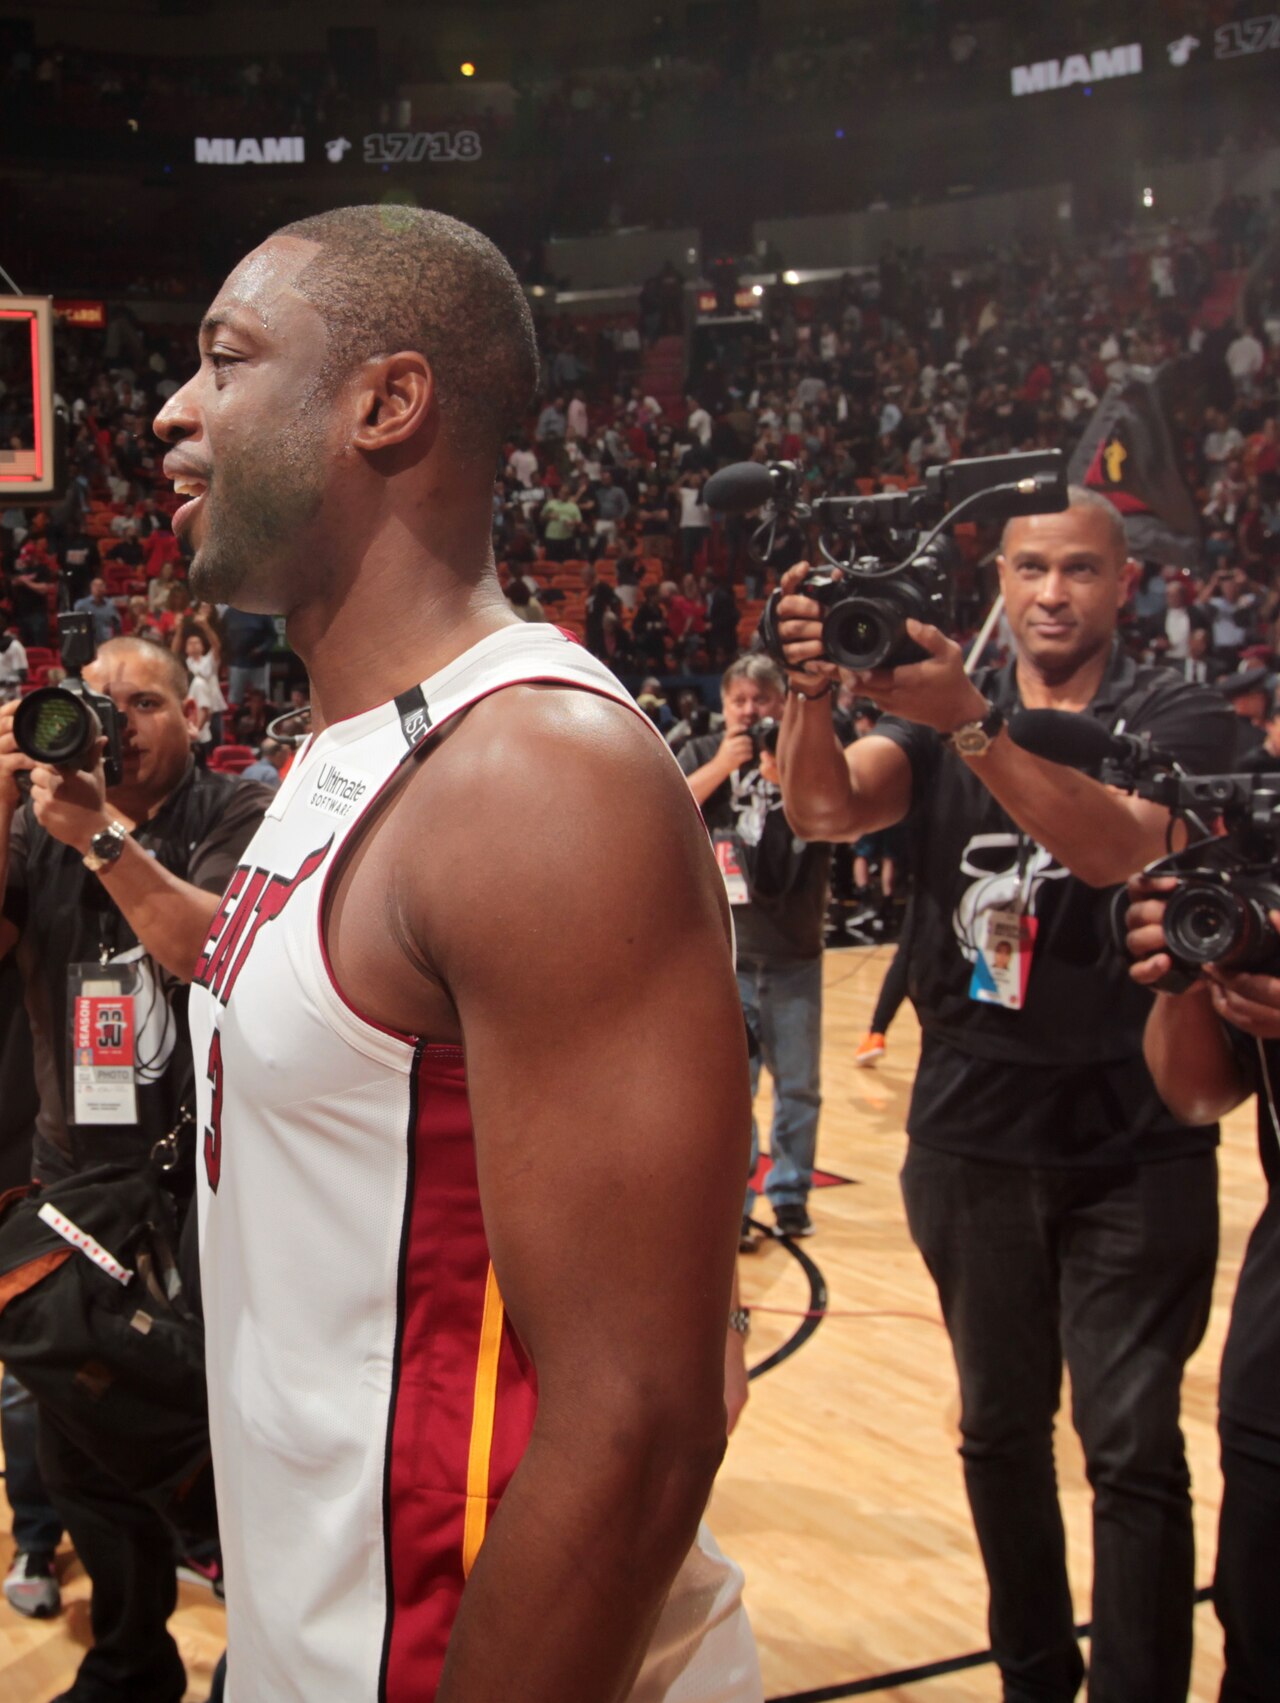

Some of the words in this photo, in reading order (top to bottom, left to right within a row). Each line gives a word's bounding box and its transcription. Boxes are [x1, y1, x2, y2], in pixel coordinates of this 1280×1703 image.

[1011, 43, 1142, 96] MIAMI
[195, 136, 304, 163] MIAMI
[363, 131, 481, 162] 17/18
[310, 793, 352, 816] SOFTWARE
[317, 763, 366, 802] Ultimate
[192, 831, 336, 1008] EAT
[79, 999, 90, 1048] SEASON
[97, 1069, 129, 1080] PHOTO
[203, 1026, 224, 1197] 3
